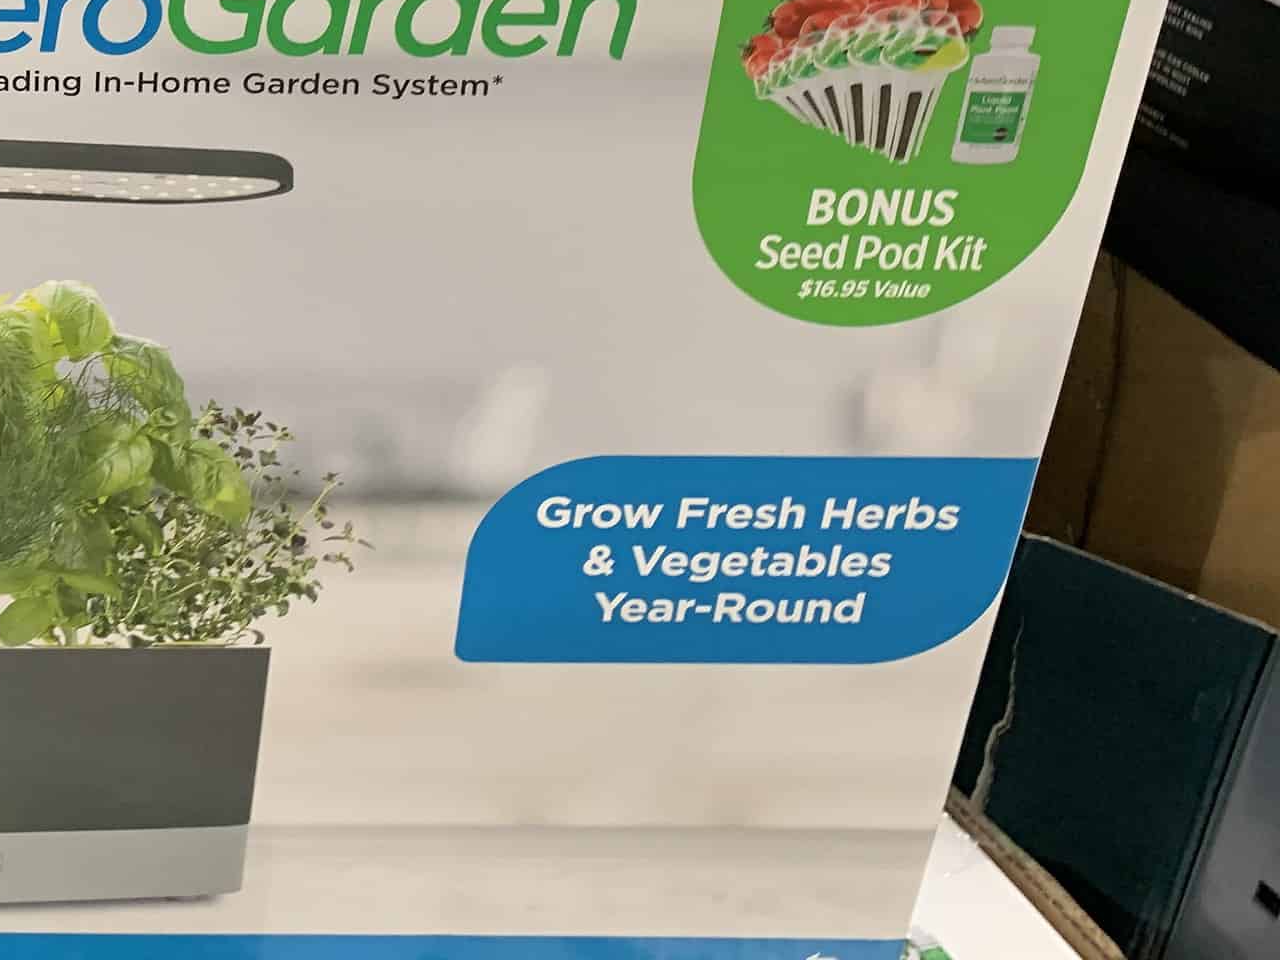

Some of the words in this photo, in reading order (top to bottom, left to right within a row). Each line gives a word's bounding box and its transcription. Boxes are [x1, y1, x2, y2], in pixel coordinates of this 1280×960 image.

[93, 71, 231, 96] In-Home
[242, 71, 361, 97] Garden
[807, 189, 959, 227] BONUS
[755, 234, 849, 271] Seed
[854, 235, 931, 272] Pod
[933, 235, 988, 272] Kit
[798, 279, 870, 300] $16.95
[874, 279, 932, 299] Value
[536, 496, 665, 530] Grow
[676, 497, 807, 531] Fresh
[821, 497, 960, 531] Herbs
[583, 544, 615, 578] &
[633, 545, 893, 584] Vegetables
[594, 591, 866, 625] Year-Round
